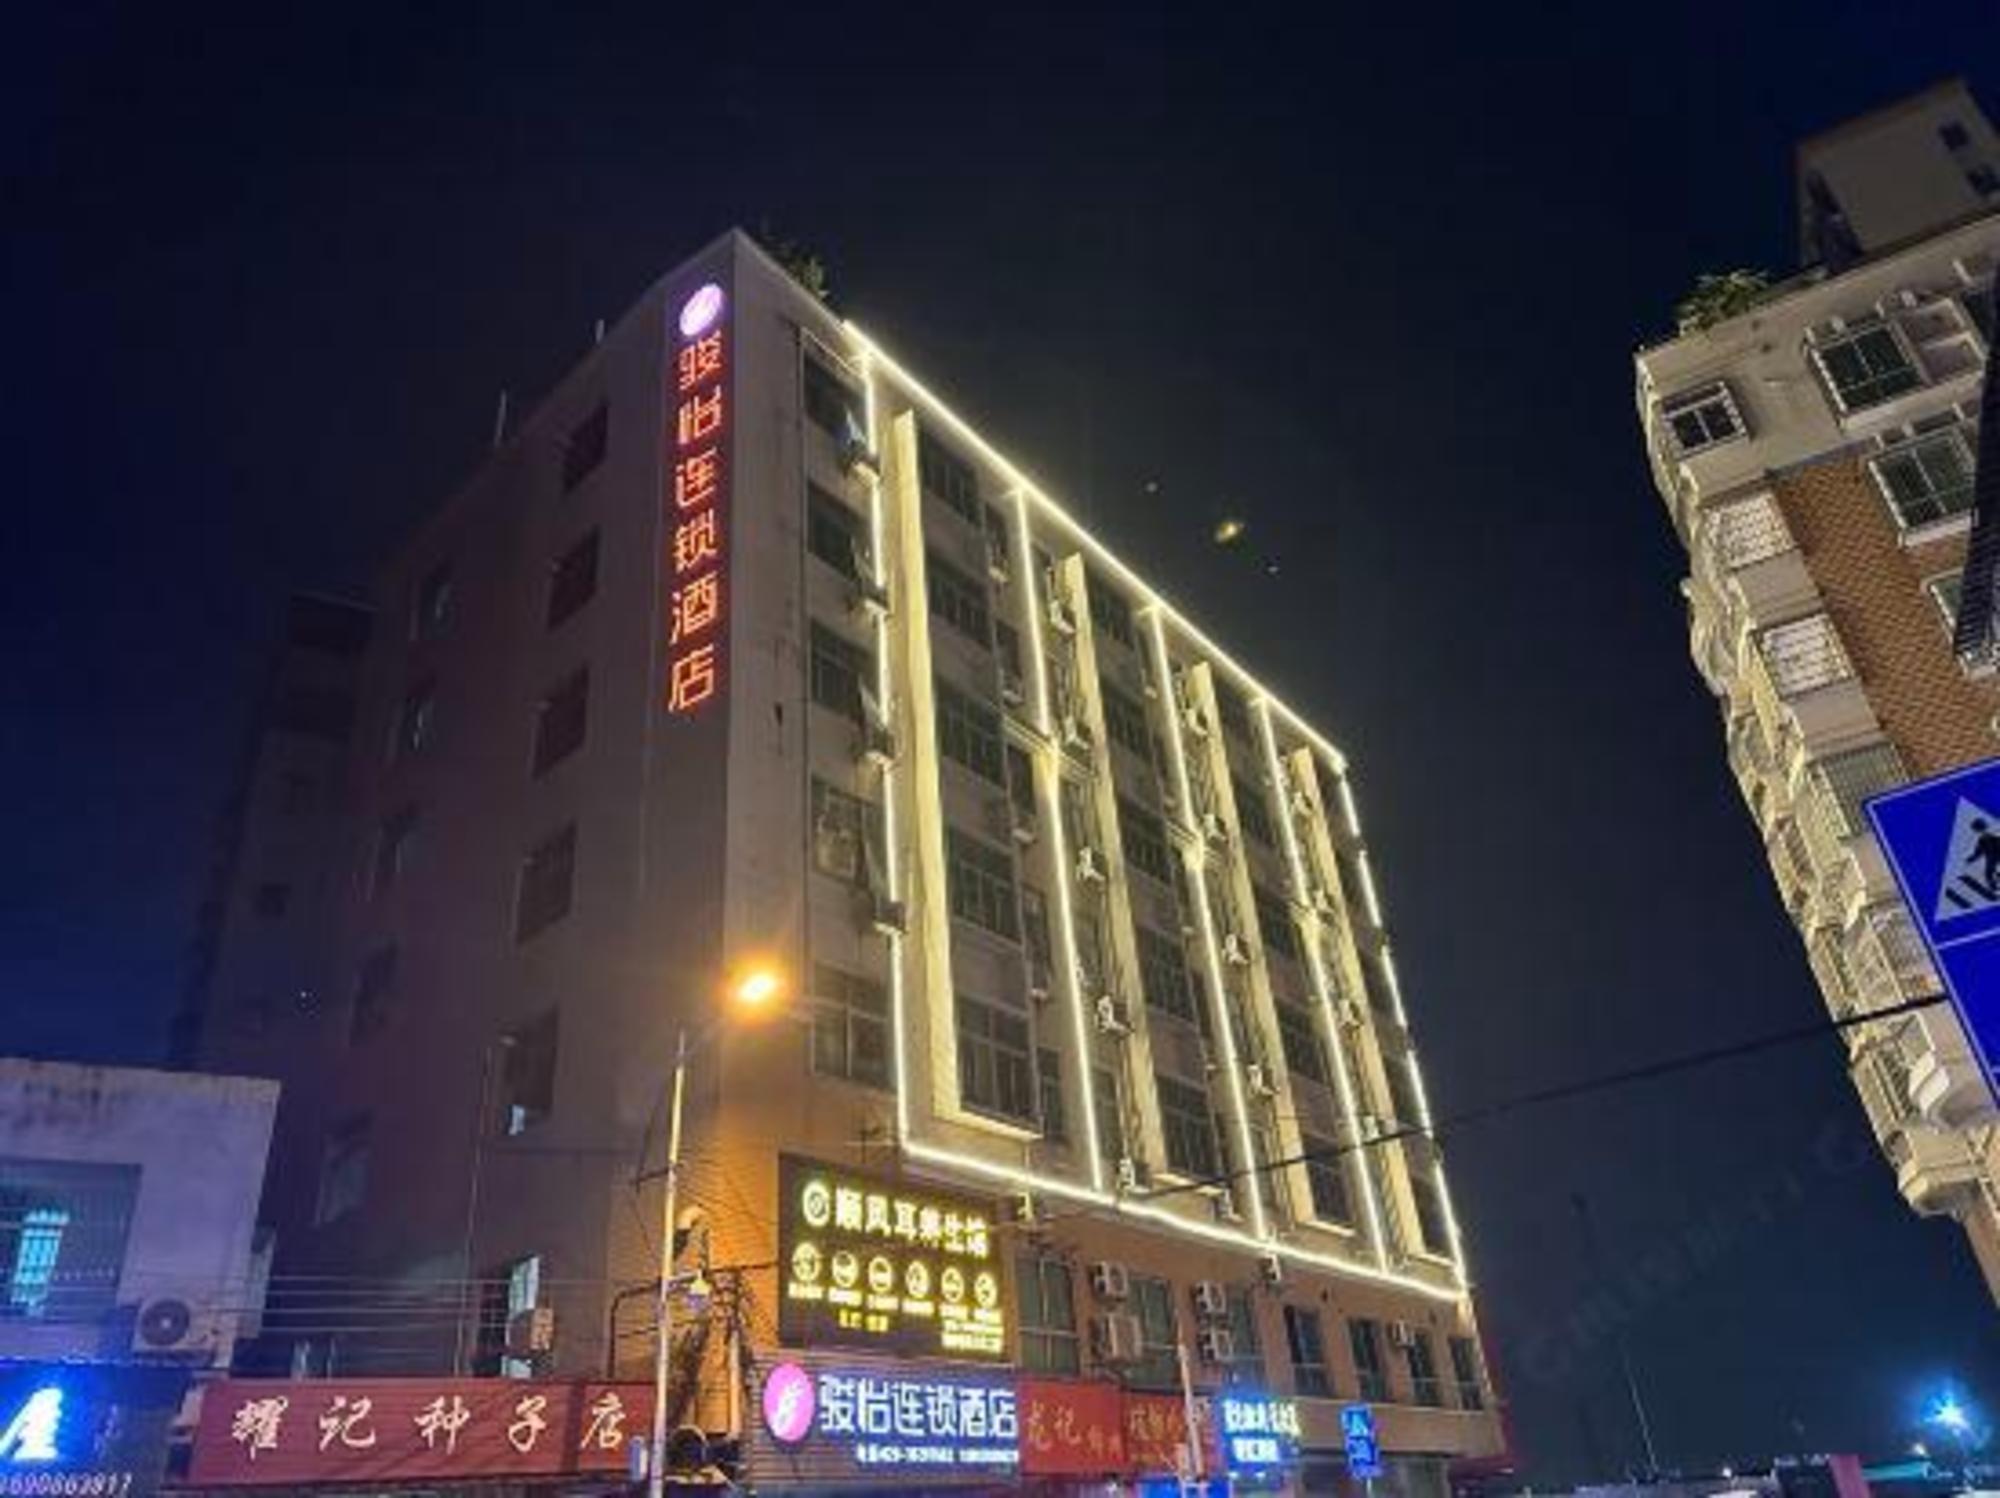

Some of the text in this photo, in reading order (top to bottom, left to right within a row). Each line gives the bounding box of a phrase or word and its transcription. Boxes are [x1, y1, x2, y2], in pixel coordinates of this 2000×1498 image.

[667, 329, 724, 712] 骏怡连锁酒店
[231, 1393, 626, 1459] 耀记种子店
[818, 1374, 1018, 1436] 骏怡连锁酒店
